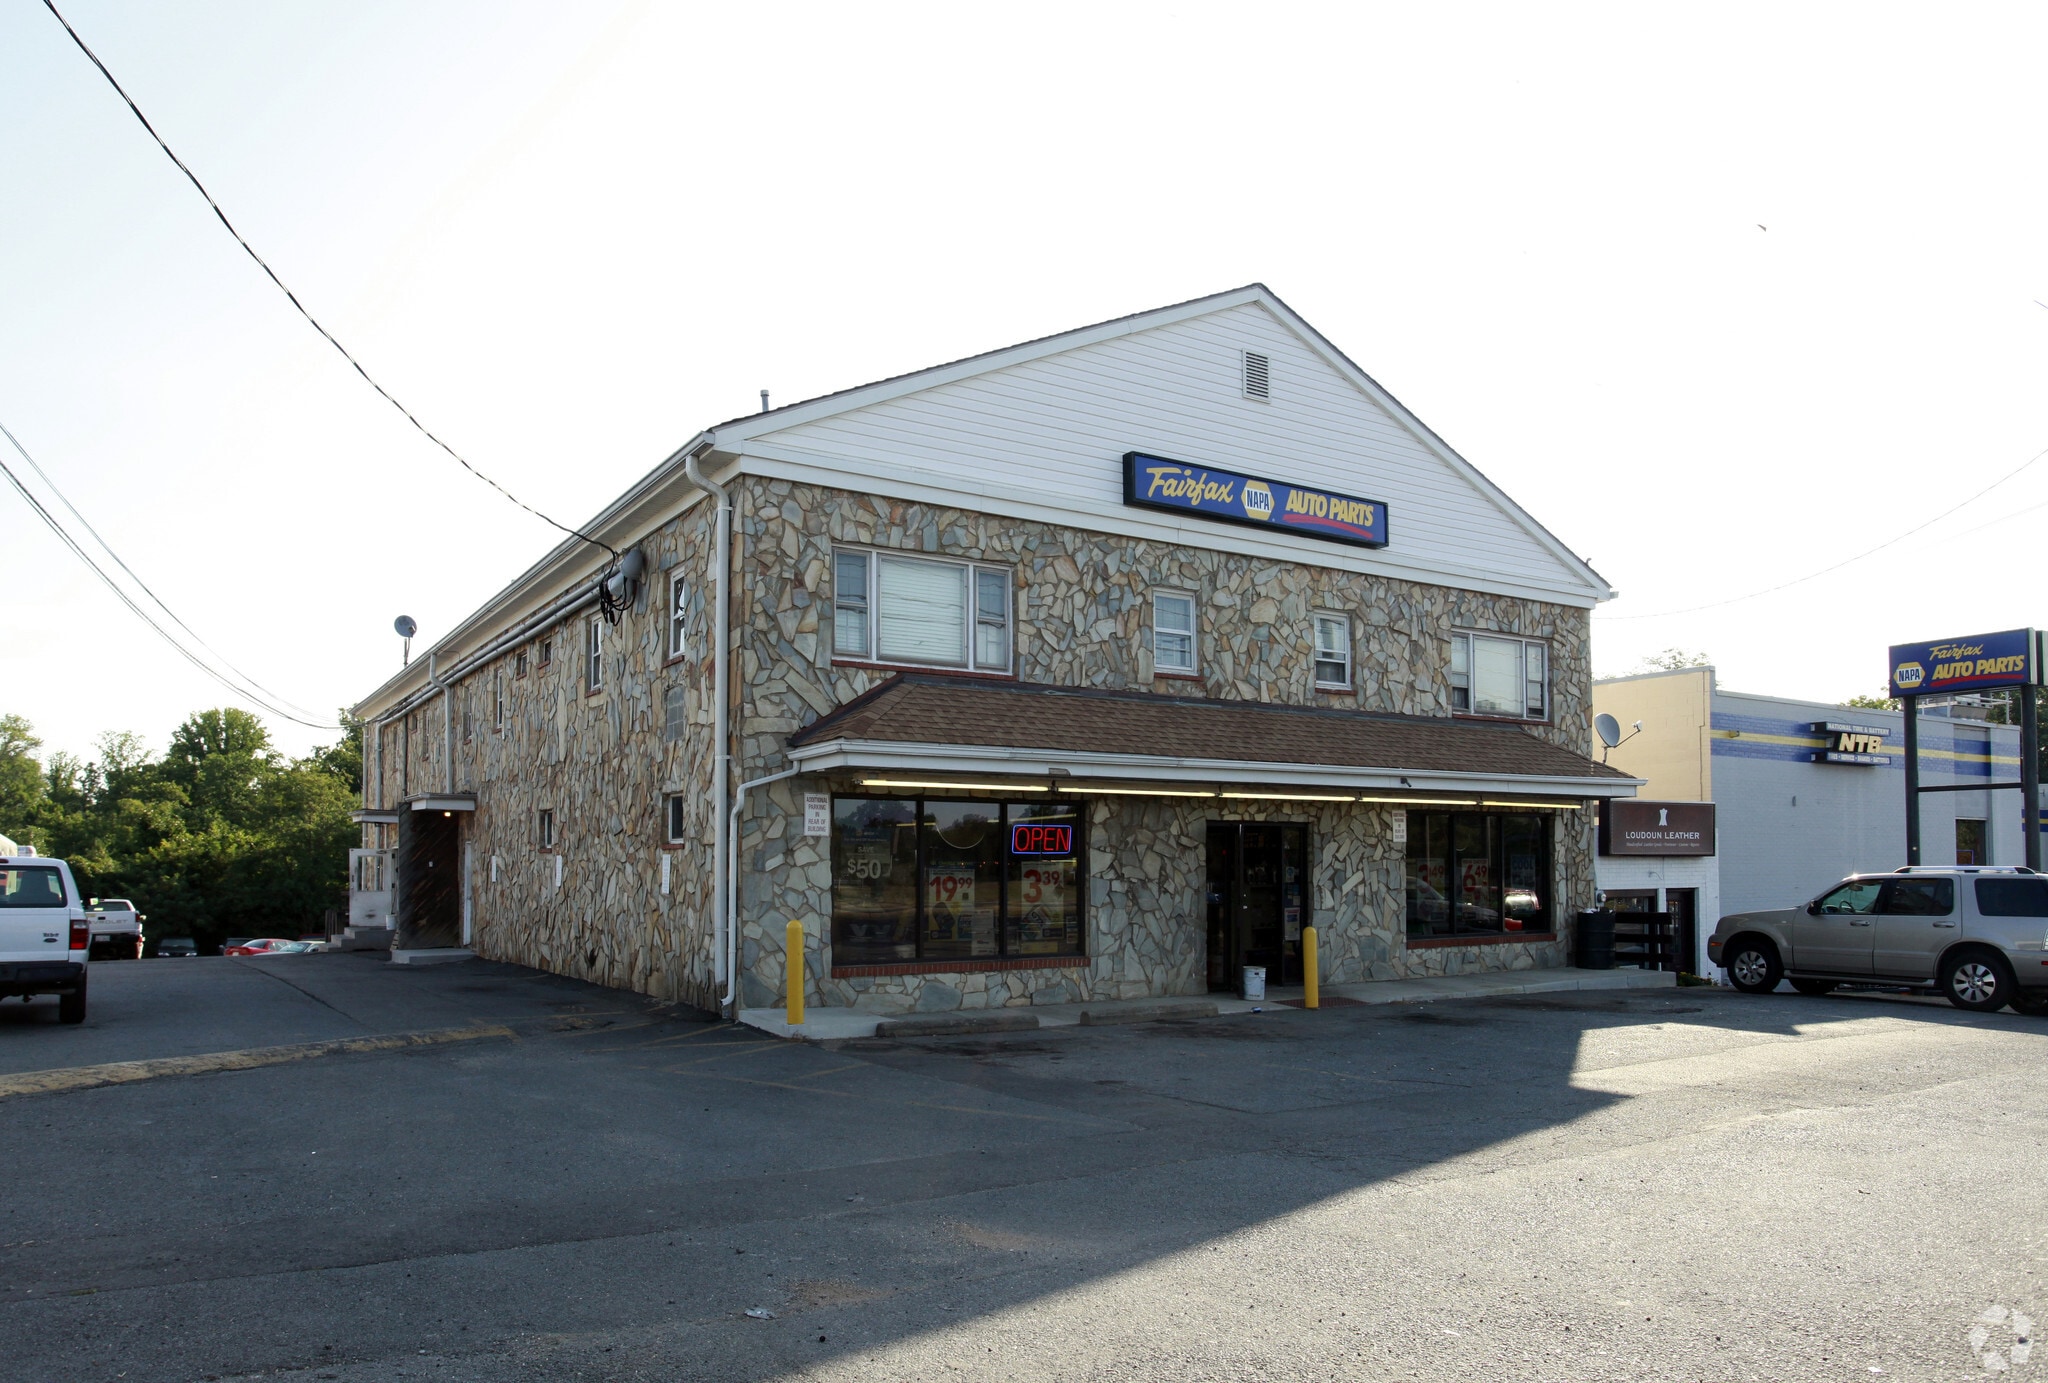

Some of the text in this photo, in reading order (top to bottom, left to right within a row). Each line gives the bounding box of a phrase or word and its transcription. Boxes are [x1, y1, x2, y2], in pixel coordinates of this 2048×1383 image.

[1146, 467, 1374, 527] Fairfax NAPA AUTO PARTS
[1929, 643, 1984, 661] Fairfax
[1898, 668, 1920, 682] NAPA
[1932, 655, 2025, 680] AUTO PARTS
[1827, 722, 1852, 731] NATIONAL
[1868, 727, 1890, 735] BATTERY
[1838, 732, 1882, 754] NTB
[1014, 827, 1070, 851] OPEN
[1625, 831, 1700, 839] LOUDOUN LEATHER
[847, 858, 882, 879] $50
